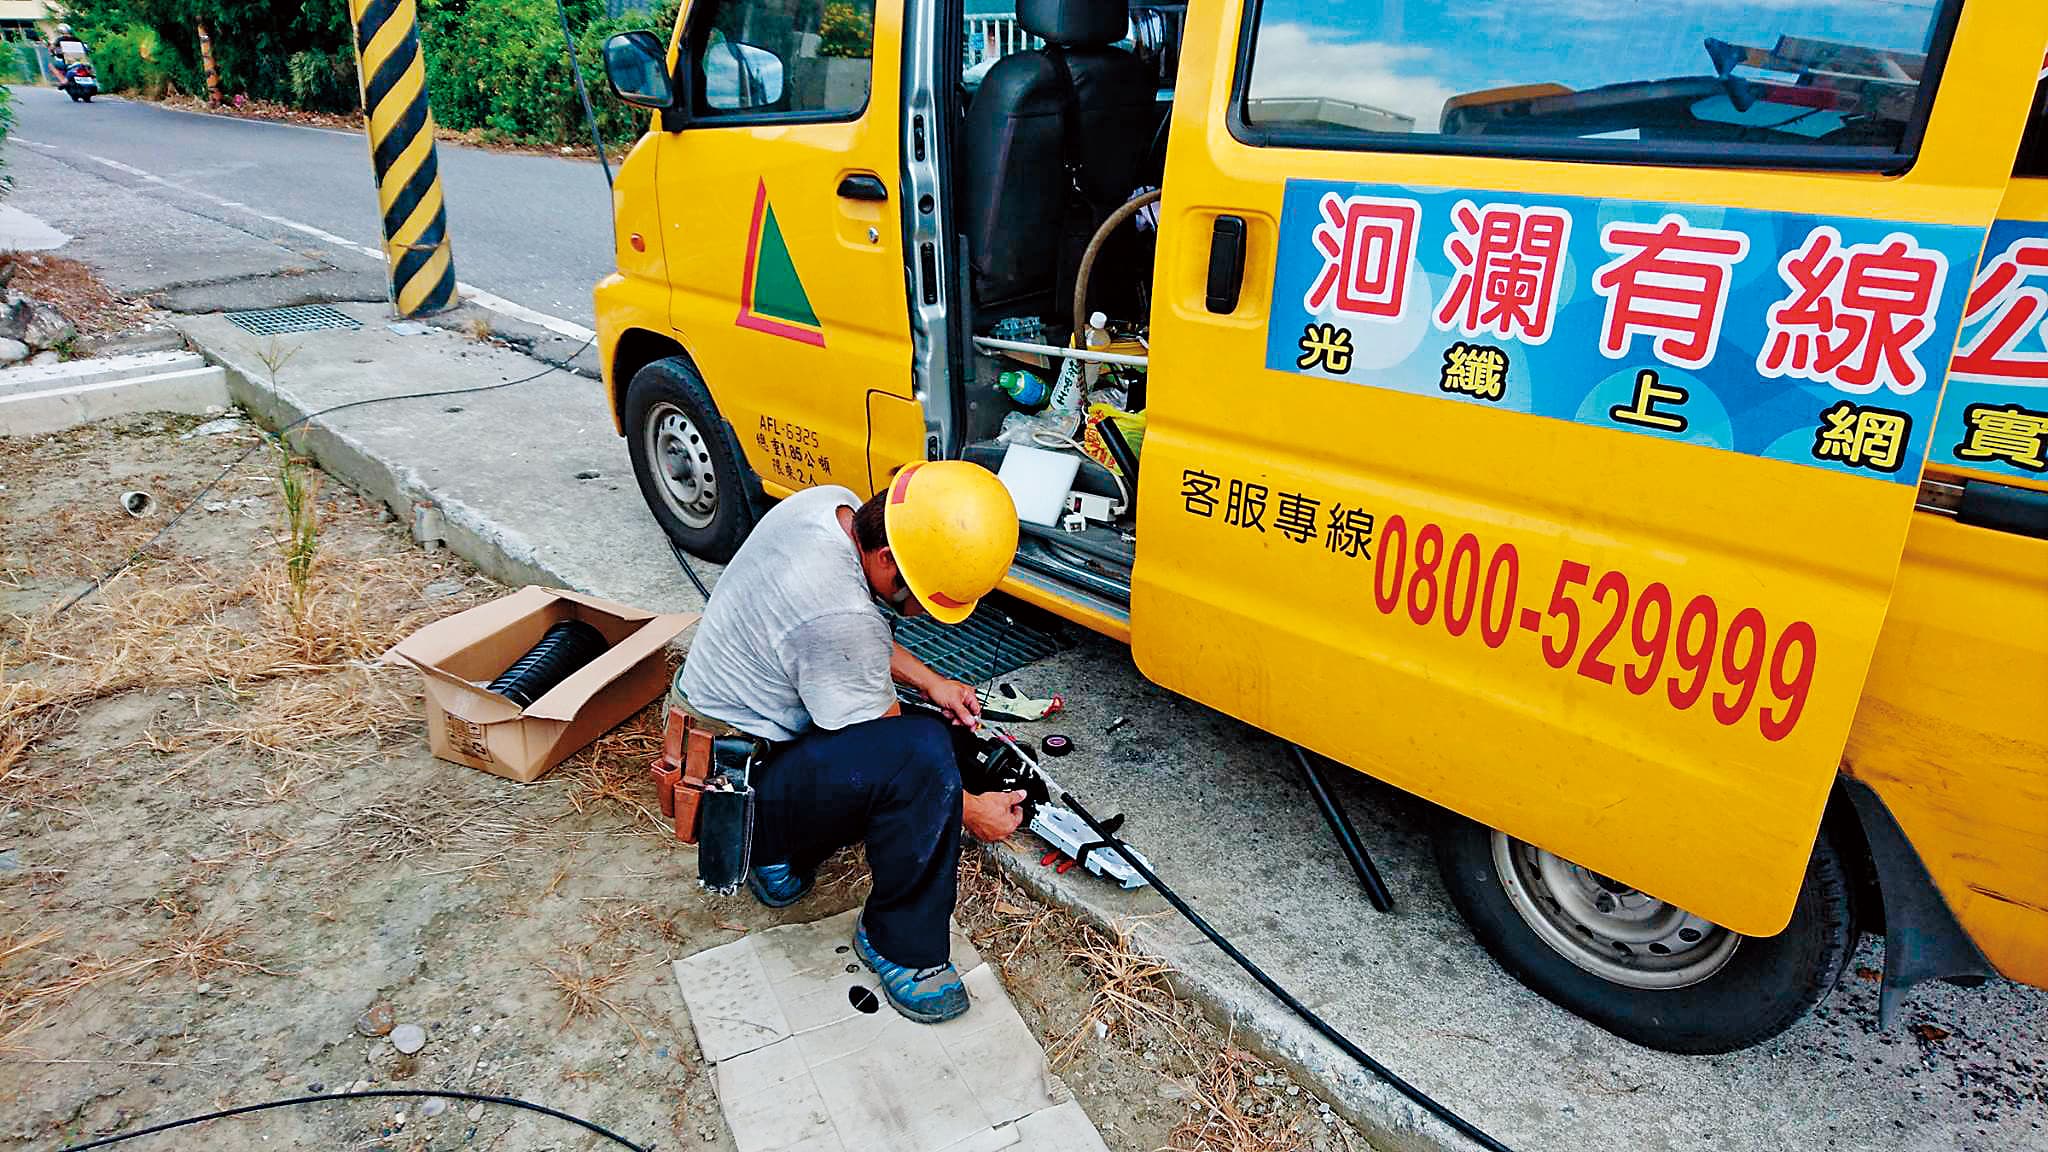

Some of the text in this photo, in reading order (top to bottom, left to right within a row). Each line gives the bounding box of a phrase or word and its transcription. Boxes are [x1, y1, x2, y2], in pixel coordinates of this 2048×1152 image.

[759, 414, 819, 449] AFL-6325
[1180, 469, 1817, 743] 客服專線 0800-529999
